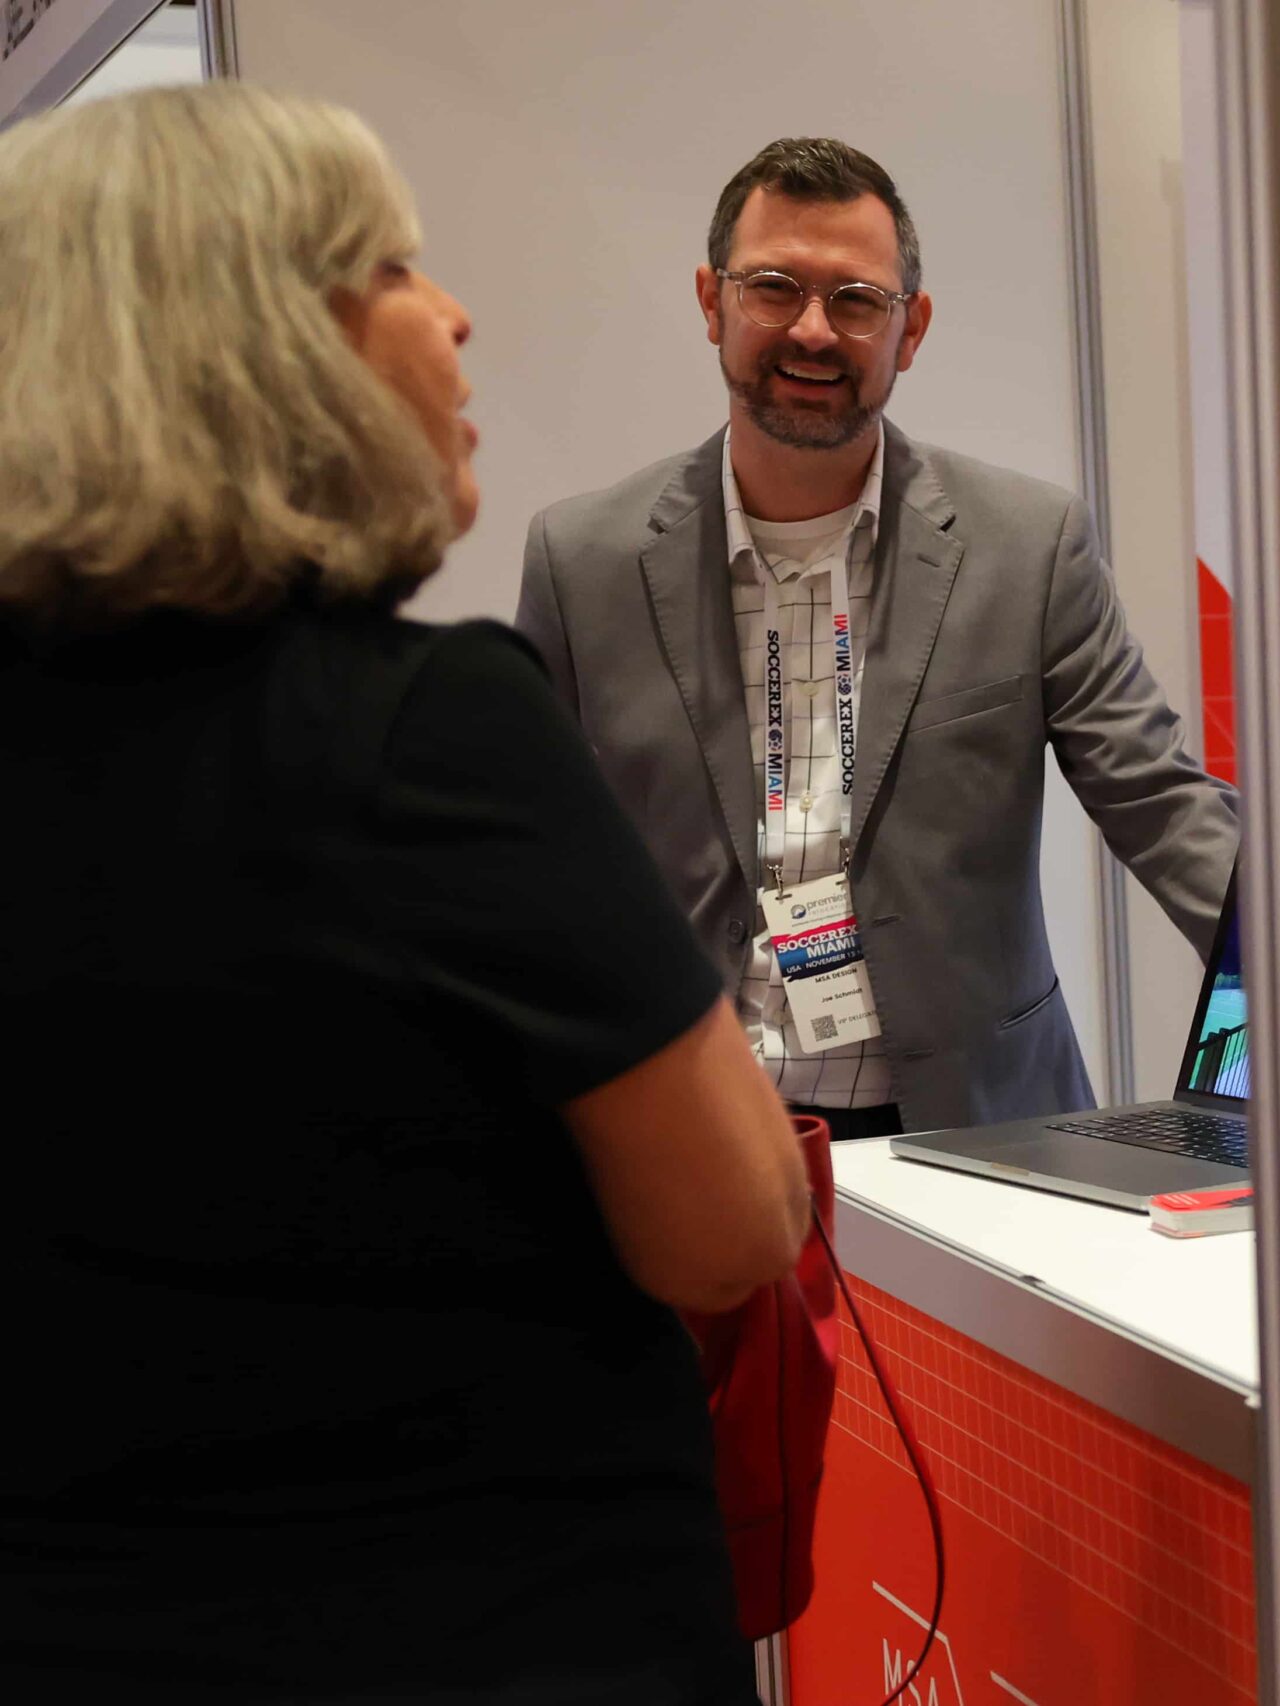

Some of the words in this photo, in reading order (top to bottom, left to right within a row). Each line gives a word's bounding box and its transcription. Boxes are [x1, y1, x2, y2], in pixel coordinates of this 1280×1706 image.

[834, 614, 850, 672] MIAMI
[768, 629, 782, 728] SOCCEREX
[839, 697, 855, 796] SOCCEREX
[768, 753, 783, 811] MIAMI
[777, 924, 858, 954] SOCCEREX
[786, 965, 802, 974] USA
[805, 954, 846, 969] NOVEMBER
[806, 936, 856, 959] MIAMI
